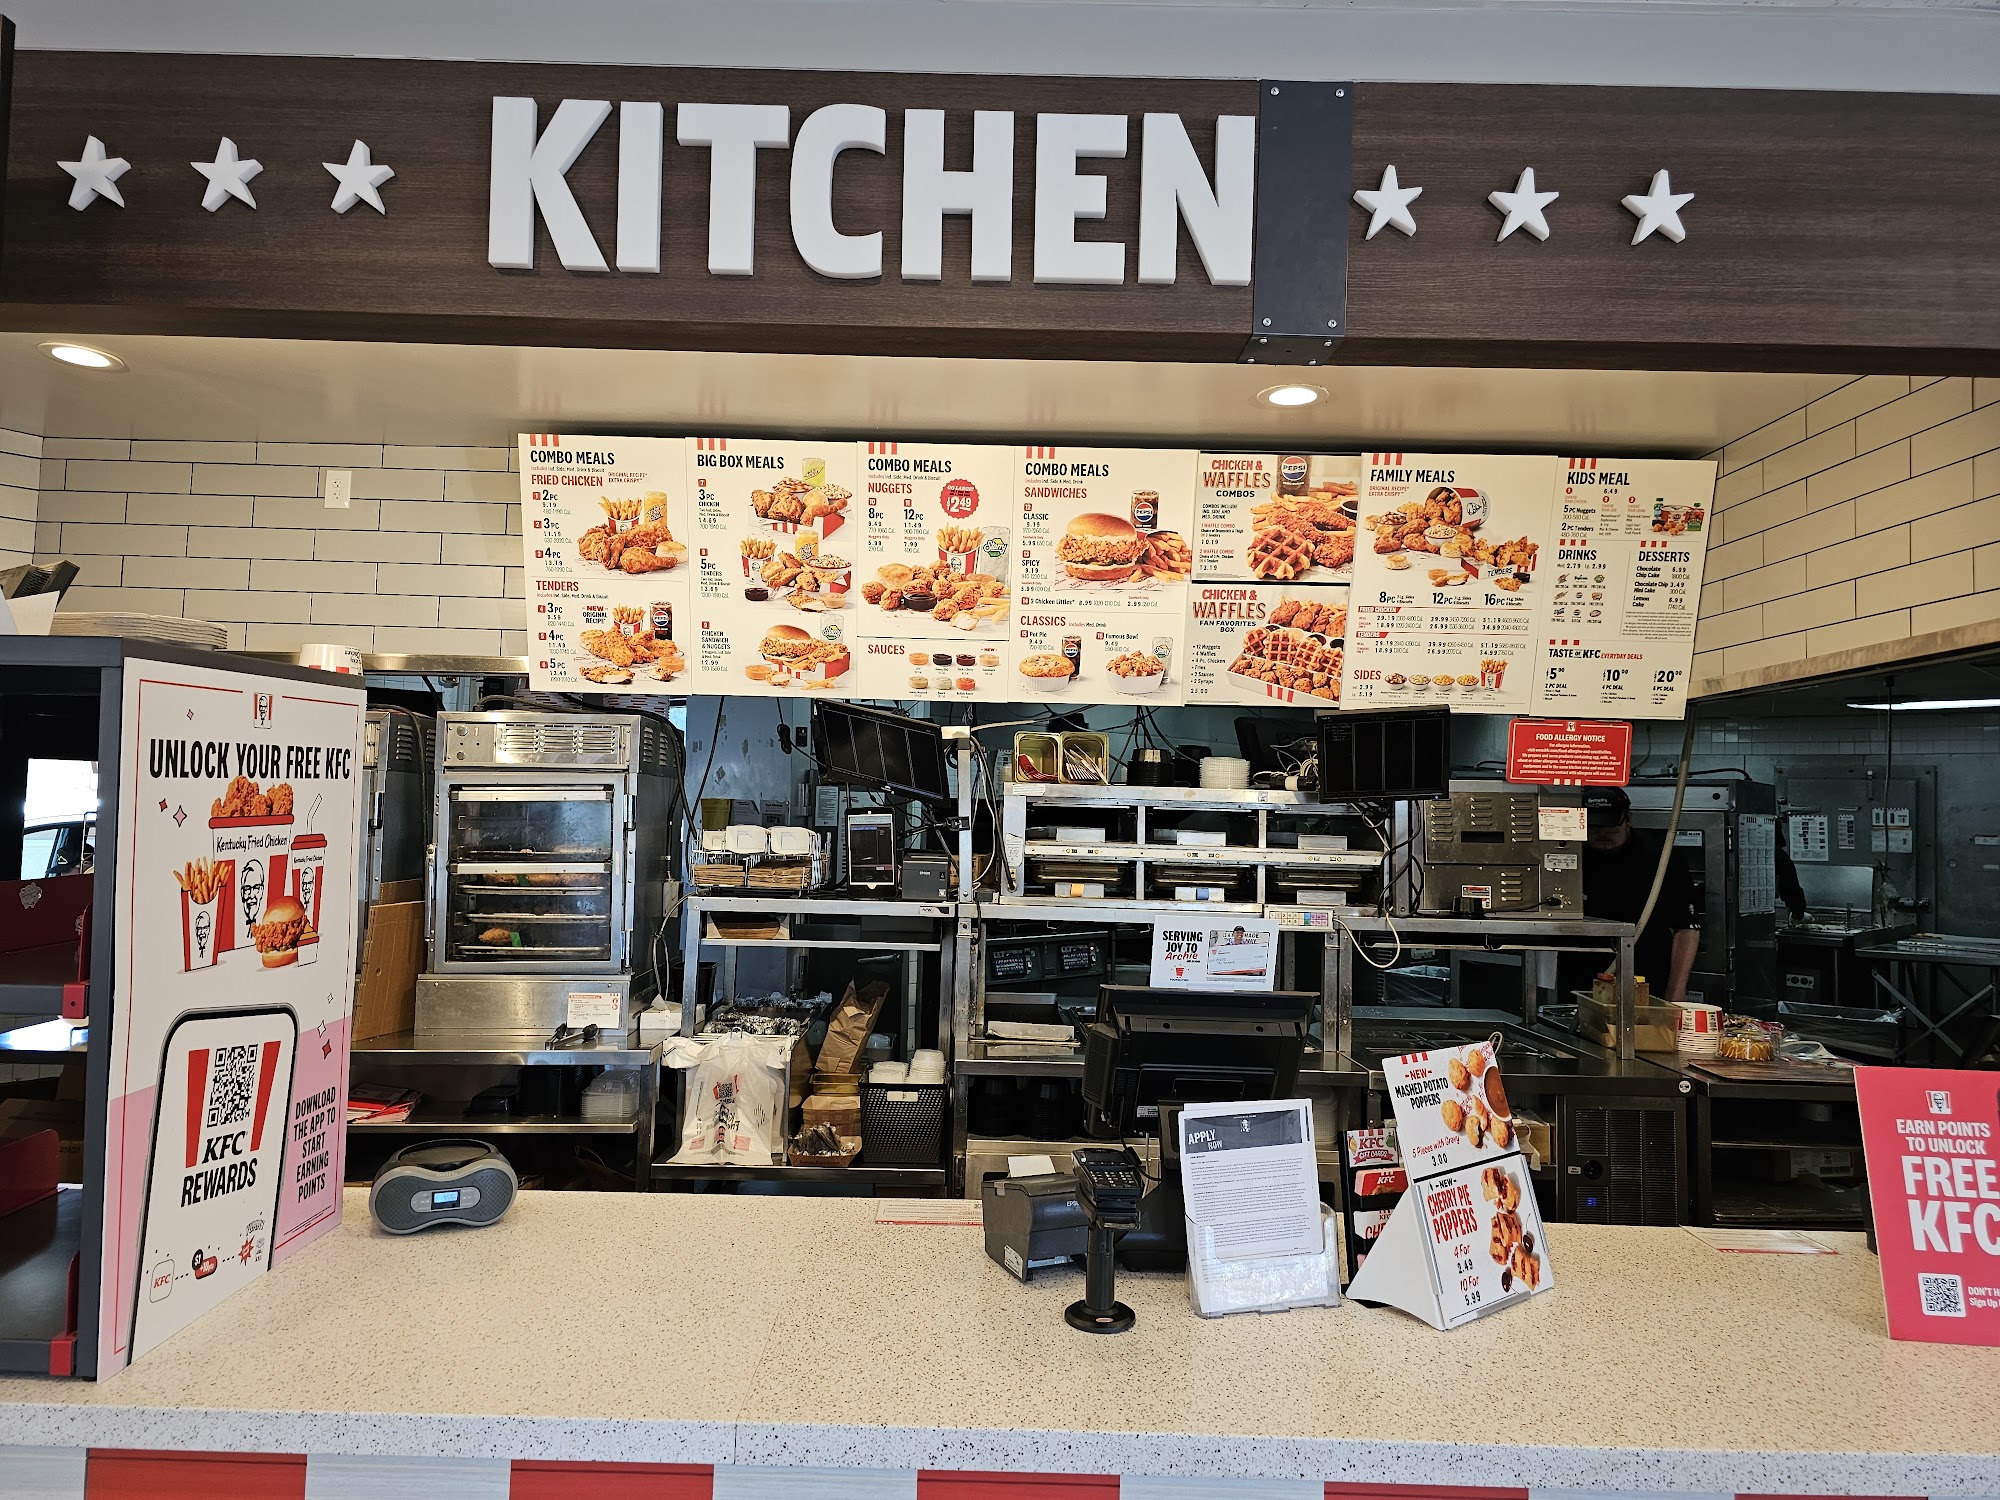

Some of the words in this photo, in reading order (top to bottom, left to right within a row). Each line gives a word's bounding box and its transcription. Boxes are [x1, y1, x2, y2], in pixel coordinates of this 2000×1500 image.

[489, 96, 1256, 284] KITCHEN
[530, 450, 573, 463] COMBO
[576, 451, 615, 465] MEALS
[697, 454, 717, 467] BIG
[720, 455, 743, 468] BOX
[746, 455, 784, 469] MEALS
[1211, 459, 1253, 471] CHICKEN
[1255, 460, 1263, 471] &
[868, 458, 910, 471] COMBO
[913, 459, 952, 473] MEALS
[1025, 463, 1068, 476] COMBO
[1071, 464, 1109, 477] MEALS
[531, 474, 559, 486] FRIED
[561, 475, 603, 487] CHICKEN
[1202, 471, 1271, 490] WAFFLES
[1370, 469, 1412, 482] FAMILY
[1415, 470, 1455, 483] MEALS
[1567, 471, 1596, 485] KIDS
[1598, 472, 1630, 486] MEAL
[868, 482, 913, 494] NUGGETS
[1024, 487, 1087, 499] SANDWICHES
[1216, 490, 1255, 498] COMBOS
[1023, 513, 1049, 521] CLASSIC
[1558, 549, 1598, 561] DRINKS
[1638, 550, 1690, 563] DESSERTS
[1487, 567, 1512, 577] TENDERS
[535, 580, 580, 592] TENDERS
[1202, 589, 1246, 601] CHICKEN
[1249, 590, 1257, 601] &
[1192, 602, 1266, 620] WAFFLES
[1020, 615, 1066, 627] CLASSICS
[867, 644, 905, 655] SAUCES
[1549, 648, 1574, 658] TASTE
[1582, 649, 1601, 659] KFC
[1353, 669, 1382, 681] SIDES
[1554, 734, 1582, 742] ALLERGY
[149, 738, 230, 779] UNLOCK
[235, 742, 281, 779] YOUR
[286, 745, 320, 779] FREE
[325, 747, 351, 779] KFC
[216, 837, 246, 853] Kentucky
[248, 835, 264, 850] Fried
[265, 834, 289, 849] Chicken
[1162, 930, 1203, 944] SERVING
[1165, 942, 1183, 953] JOY
[1186, 943, 1198, 953] TO
[1165, 951, 1198, 961] Archie
[1394, 1079, 1423, 1099] MASHED
[1423, 1076, 1450, 1093] POTATO
[296, 1086, 336, 1120] DOWNLOAD
[1410, 1093, 1442, 1111] POPPERS
[294, 1122, 311, 1142] THE
[311, 1117, 326, 1137] APP
[327, 1108, 336, 1127] TO
[1896, 1118, 1936, 1135] EARN
[1938, 1121, 1991, 1138] POINTS
[1187, 1128, 1216, 1146] APPLY
[1358, 1137, 1384, 1149] KFC
[202, 1130, 247, 1164] KFC
[302, 1131, 325, 1160] START
[1207, 1139, 1223, 1151] NOW
[1412, 1149, 1417, 1158] 5
[1417, 1144, 1433, 1156] Pieces
[1433, 1140, 1445, 1152] with
[1445, 1135, 1462, 1148] Gravy
[1905, 1136, 1926, 1152] TO
[1928, 1137, 1987, 1155] UNLOCK
[297, 1150, 329, 1185] EARNING
[1431, 1155, 1449, 1168] 3.00
[181, 1157, 258, 1208] REWARDS
[1377, 1175, 1395, 1185] KFC
[1901, 1155, 2000, 1199] FREE
[298, 1172, 325, 1204] POINTS
[1427, 1189, 1457, 1217] CHERRY
[1457, 1184, 1472, 1207] PIE
[1432, 1207, 1478, 1244] POPPERS
[1907, 1198, 2000, 1256] KFC
[1454, 1247, 1459, 1258] 4
[1459, 1243, 1471, 1256] For
[1457, 1259, 1474, 1275] 2.49
[153, 1273, 171, 1289] KFC
[1459, 1278, 1467, 1293] 10
[1467, 1275, 1480, 1288] For
[1968, 1286, 1992, 1297] DON'T
[1969, 1297, 1986, 1309] Sign
[1987, 1298, 1998, 1310] Up
